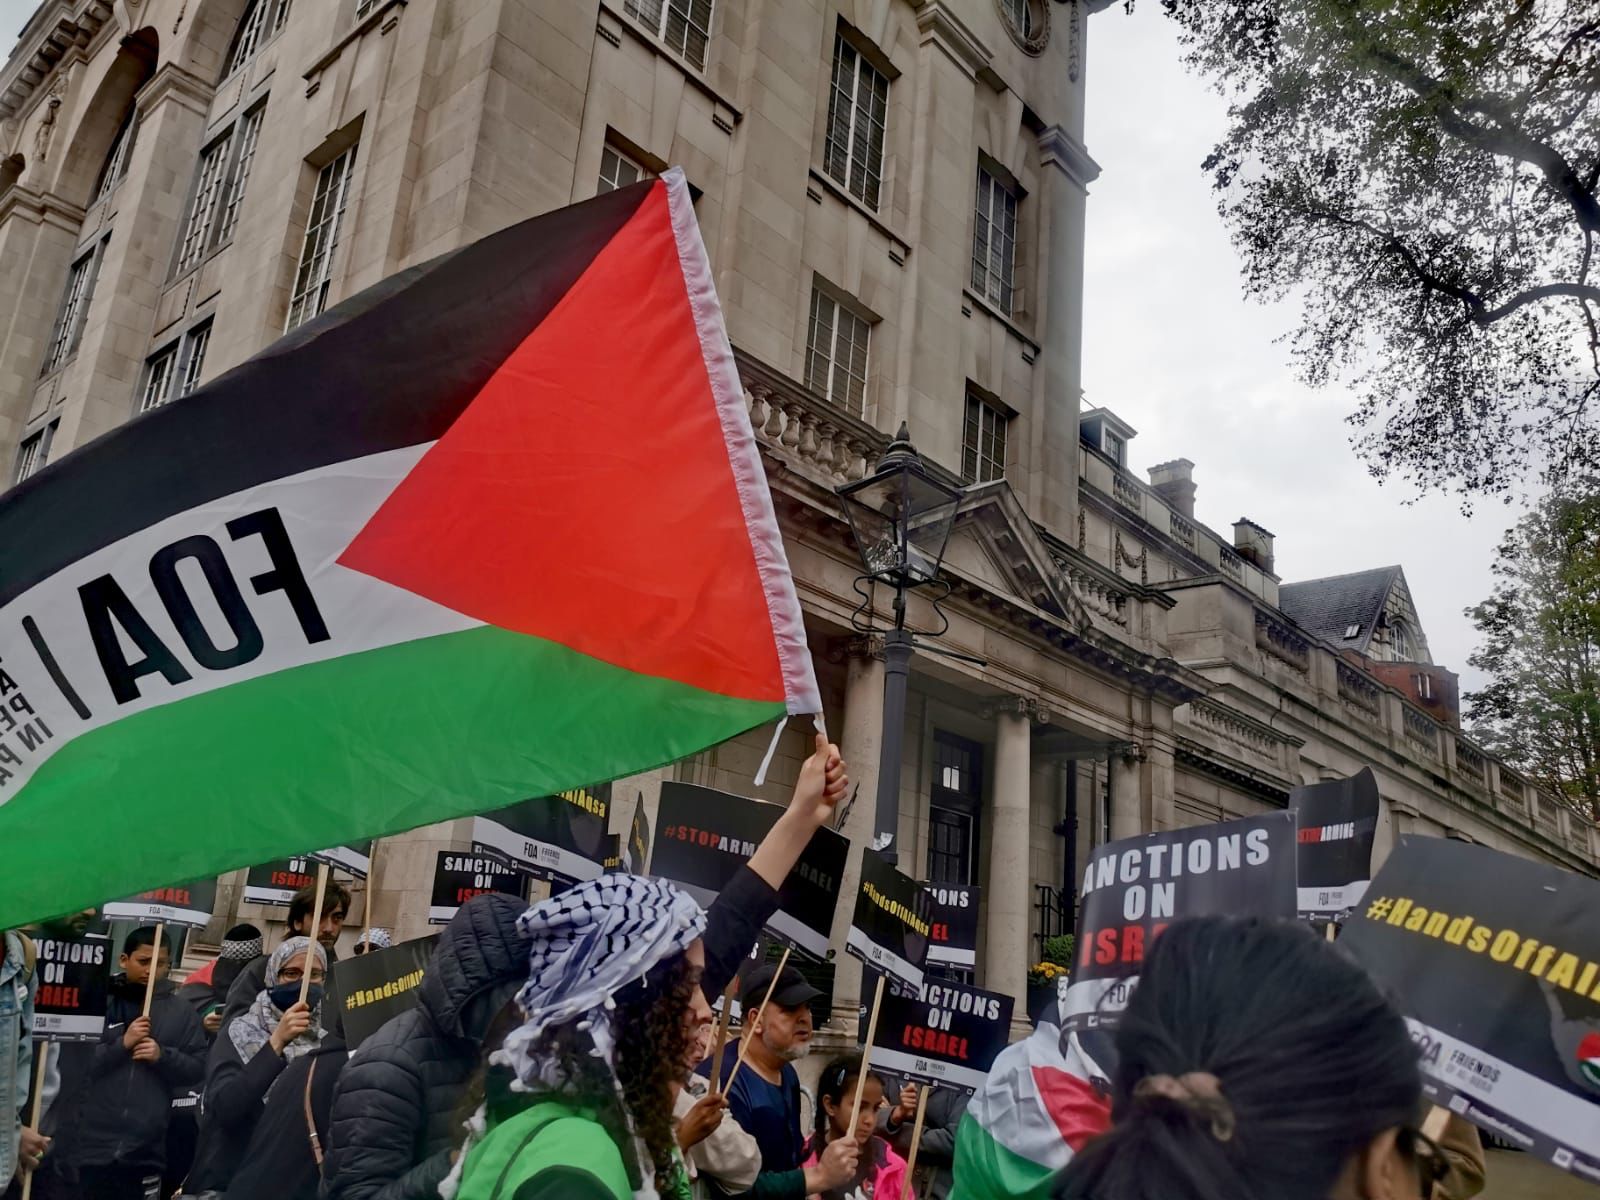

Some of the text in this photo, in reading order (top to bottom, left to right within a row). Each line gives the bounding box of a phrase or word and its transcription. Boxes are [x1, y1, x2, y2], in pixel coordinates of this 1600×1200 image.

[474, 874, 492, 889] ON
[1123, 882, 1175, 921] ON
[1081, 922, 1169, 968] ISR
[44, 962, 65, 984] ON
[927, 1007, 953, 1032] ON
[902, 1024, 970, 1060] ISRAEL
[1450, 1049, 1502, 1083] FRIENDS
